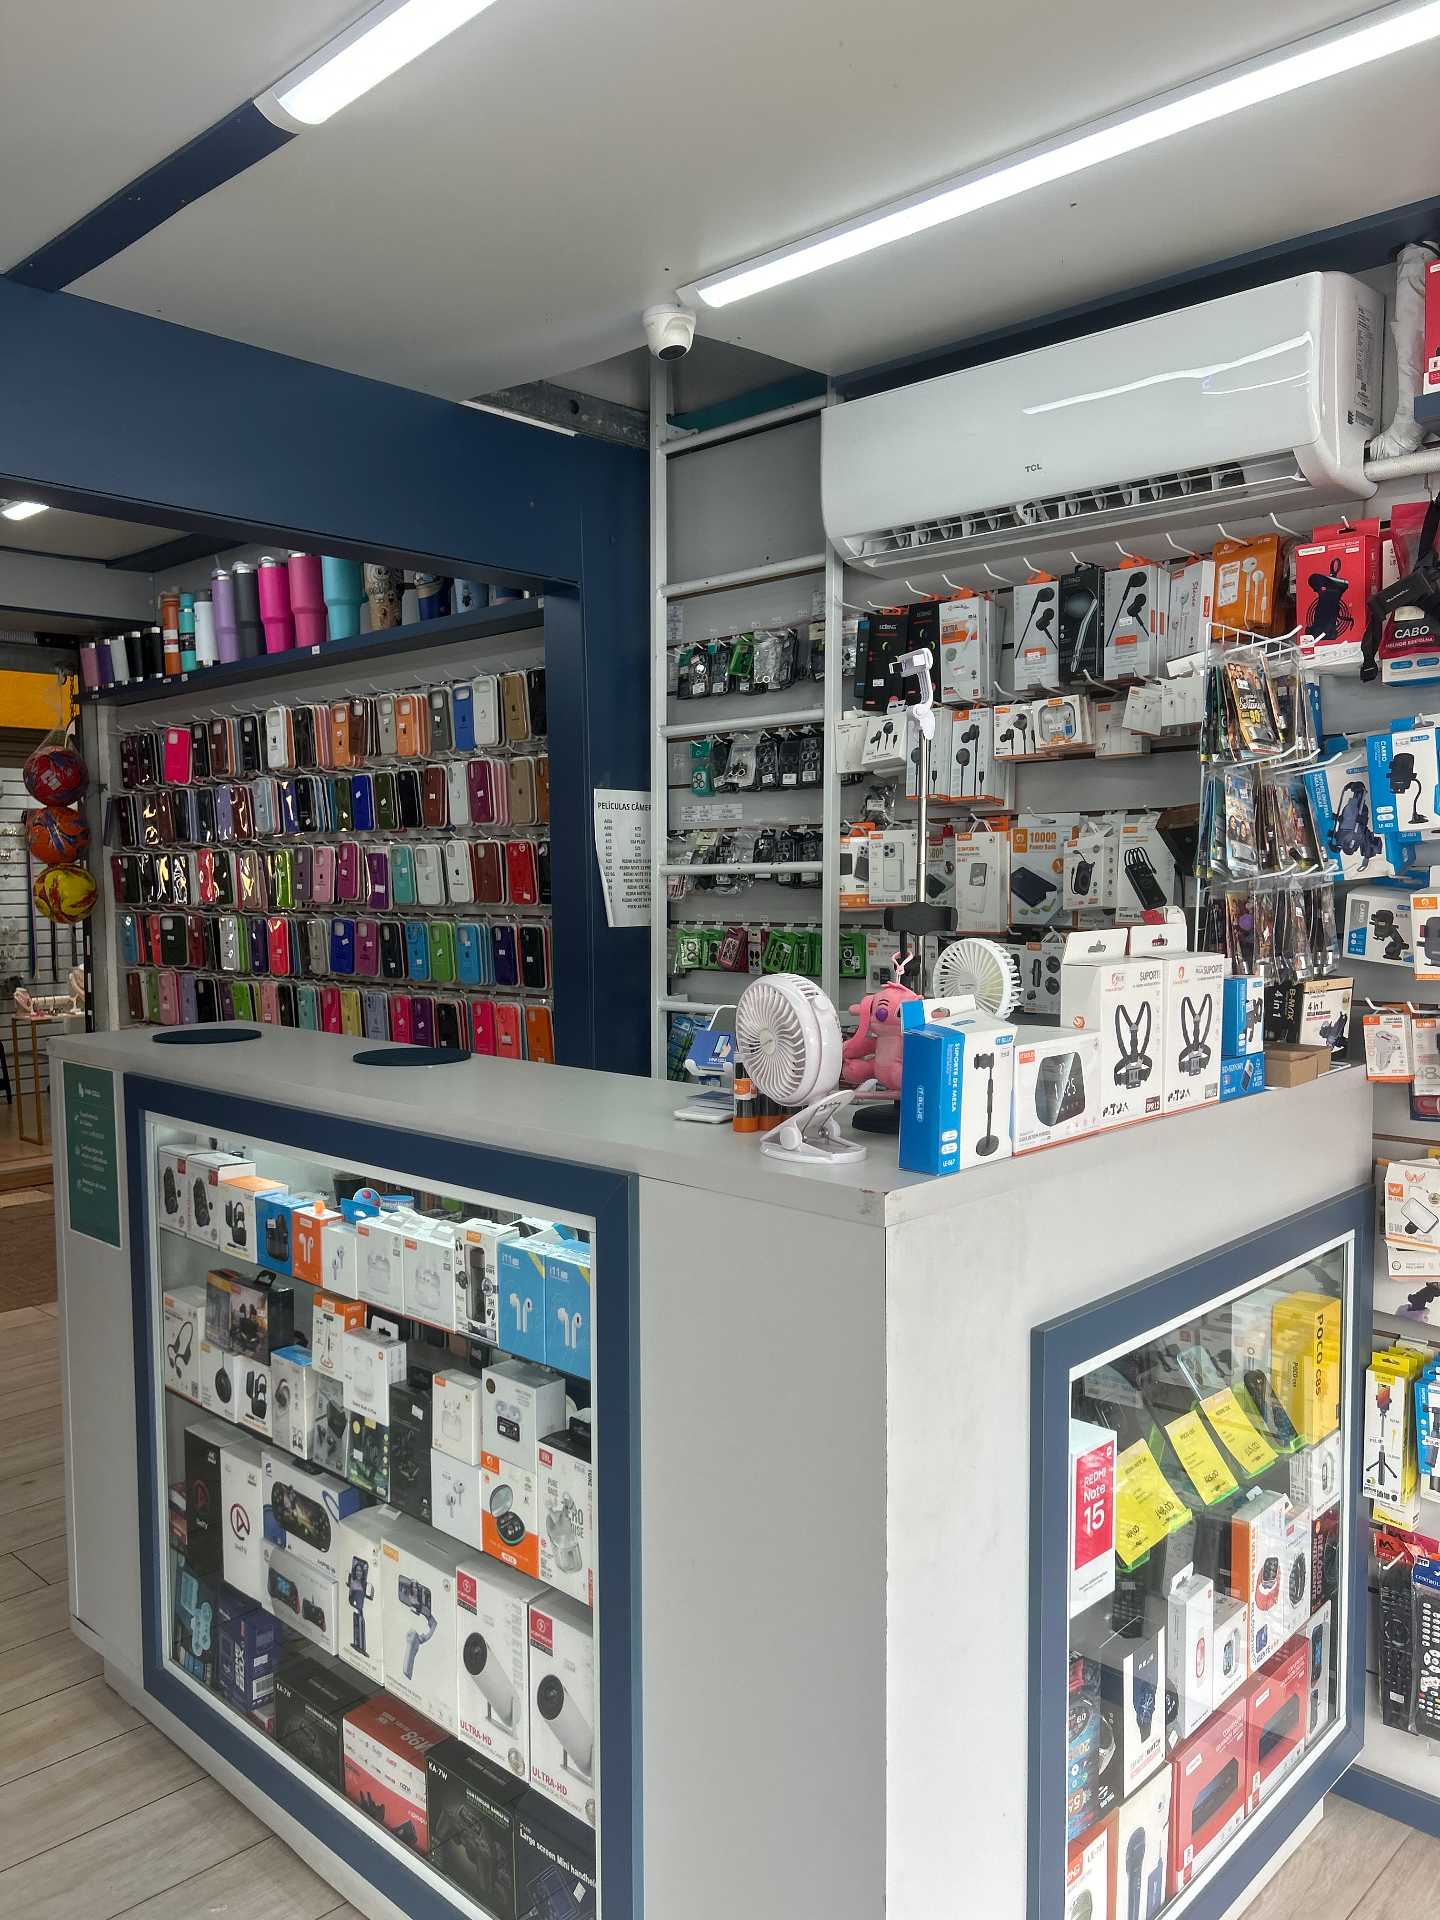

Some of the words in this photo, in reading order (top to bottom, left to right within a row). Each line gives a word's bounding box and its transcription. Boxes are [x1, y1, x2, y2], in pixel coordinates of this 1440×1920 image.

[1025, 463, 1042, 473] TCL
[1395, 625, 1430, 639] CABO
[1249, 709, 1261, 723] 90
[597, 800, 631, 811] PELÍCULAS
[631, 801, 652, 812] CÂMER
[1029, 832, 1057, 843] 10000
[1140, 970, 1161, 981] SUPORTE
[1203, 964, 1222, 975] SUPORTE
[1273, 1000, 1283, 1010] in
[1366, 1028, 1376, 1057] TURBO
[953, 1043, 961, 1077] SUPORTE
[1315, 1313, 1324, 1365] POCO
[1314, 1369, 1322, 1396] C85
[541, 1451, 551, 1464] JBL
[547, 1477, 558, 1489] PURE
[1084, 1467, 1107, 1487] REDMI
[1083, 1483, 1106, 1504] Note
[1083, 1499, 1105, 1535] 15
[1415, 1574, 1440, 1587] CONTROL
[459, 1719, 492, 1746] ULTRA-HD
[428, 1761, 448, 1781] KA-7W
[532, 1766, 568, 1796] ULTRA-HD
[520, 1828, 536, 1847] Large
[536, 1842, 556, 1862] screen
[556, 1855, 570, 1871] Mini
